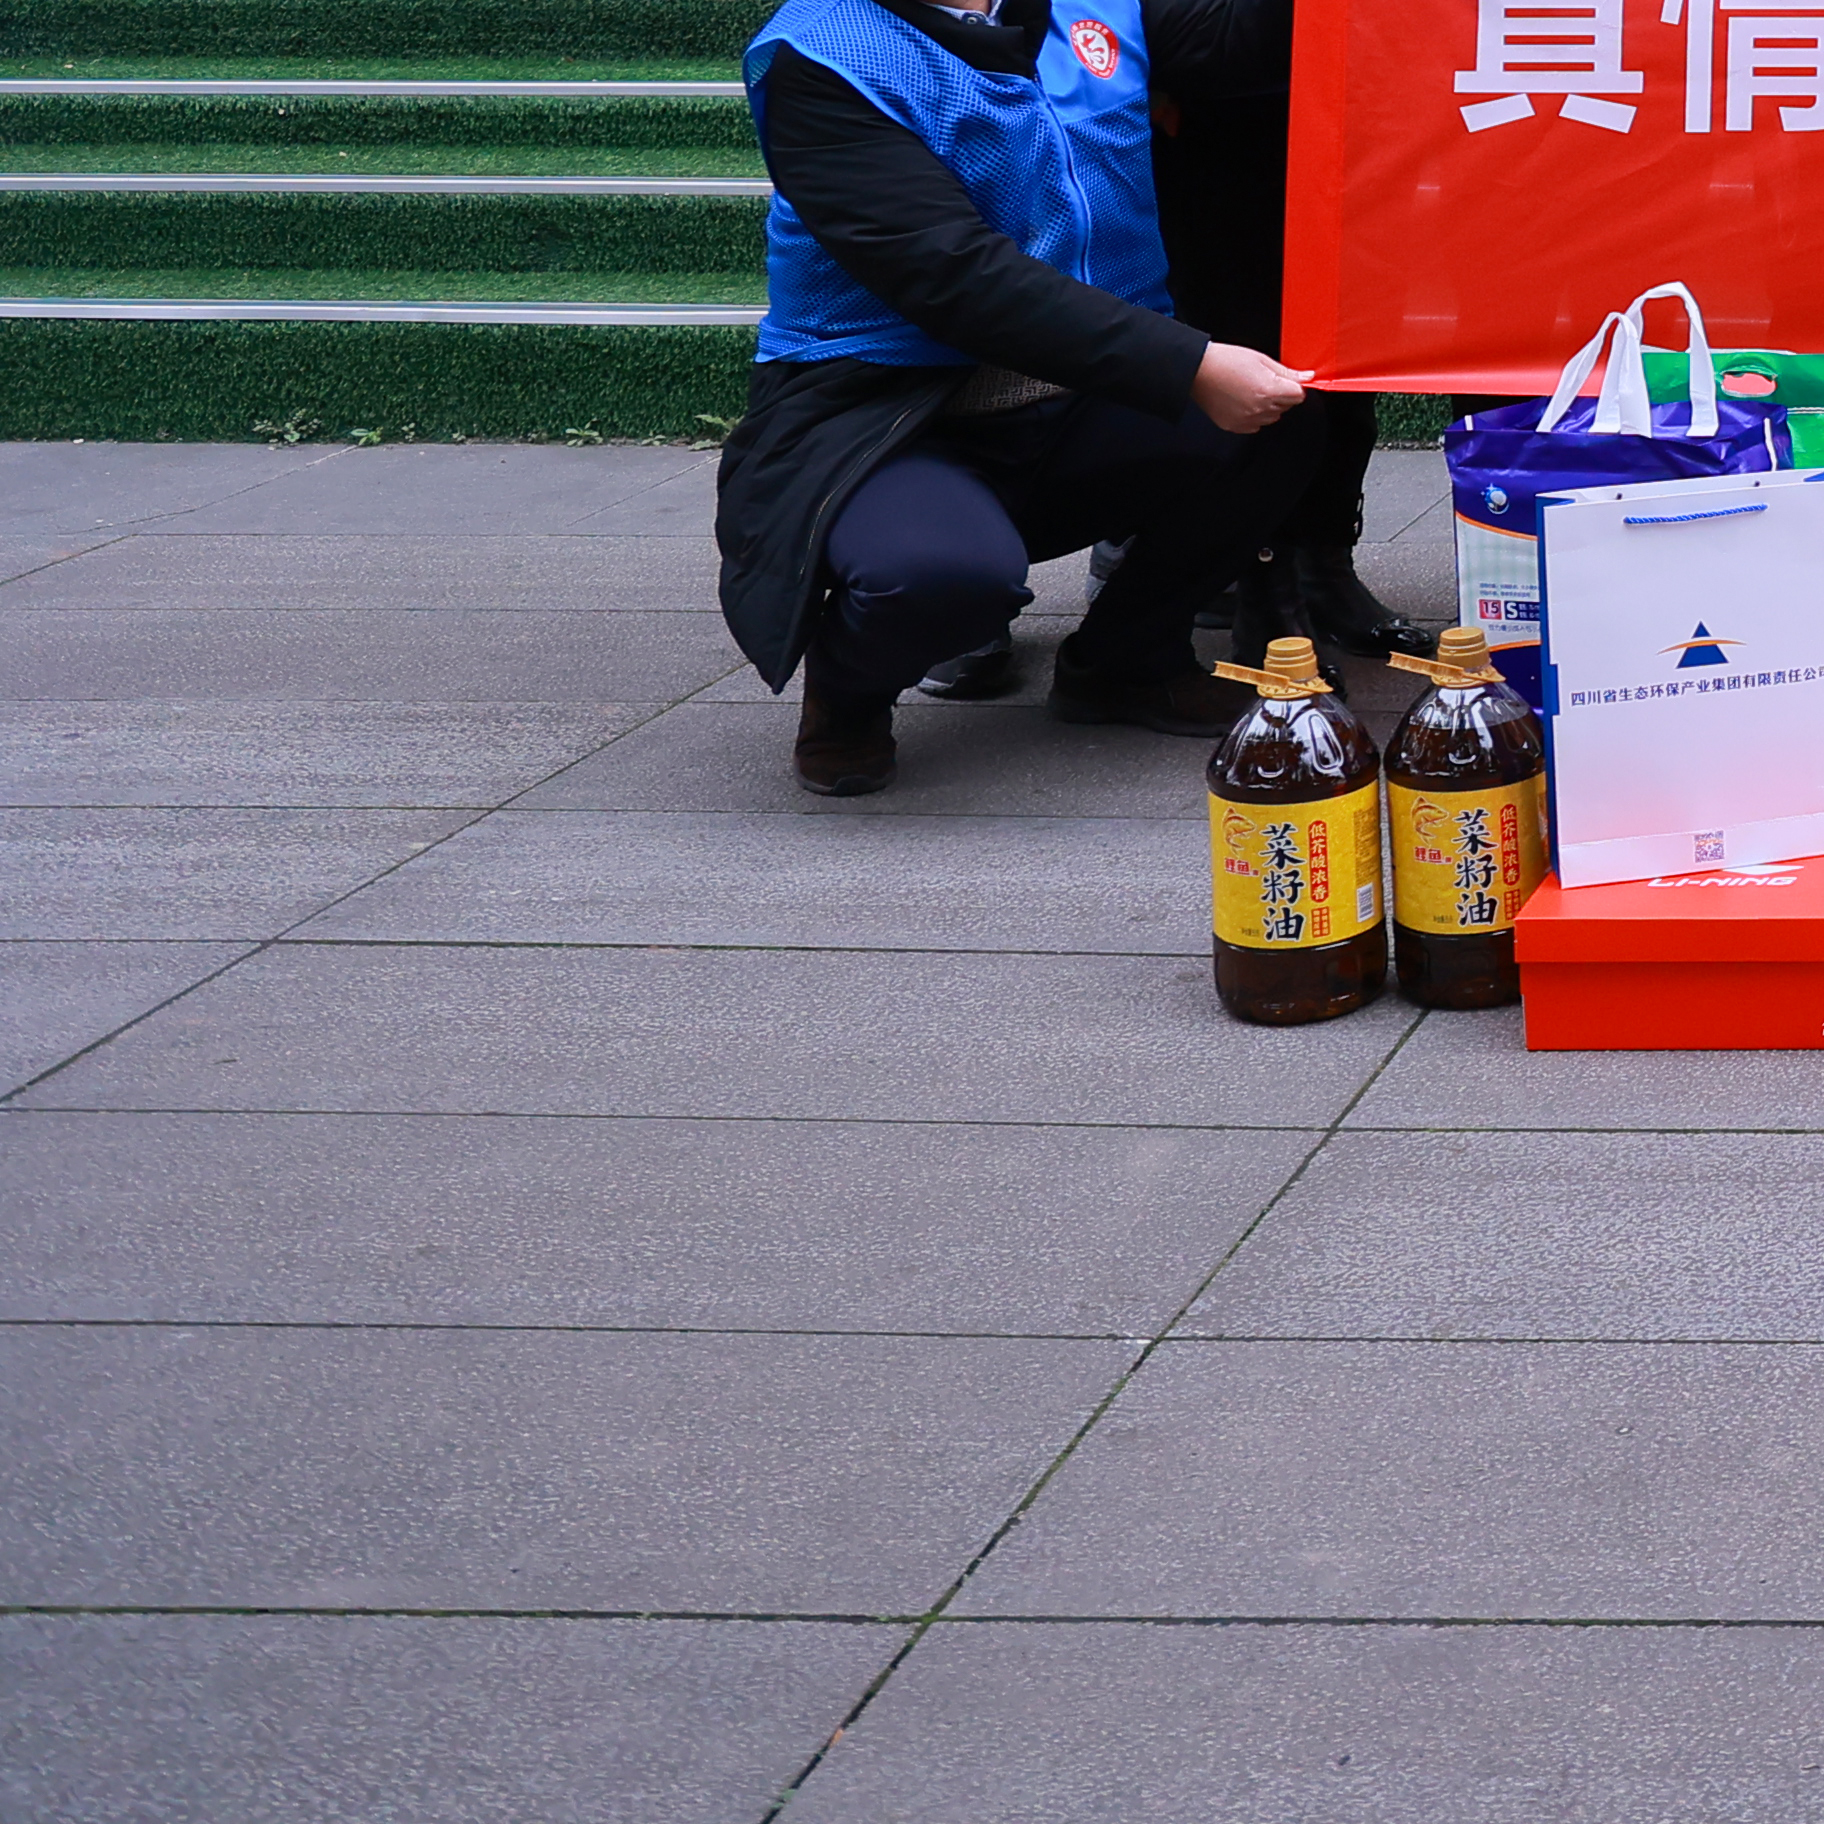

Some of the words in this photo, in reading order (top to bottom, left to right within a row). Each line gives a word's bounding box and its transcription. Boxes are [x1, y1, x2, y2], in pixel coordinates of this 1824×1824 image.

[1483, 600, 1501, 616] 15
[1506, 601, 1519, 619] S
[1259, 821, 1306, 943] 菜籽油
[1451, 808, 1499, 927] 菜籽油
[1648, 876, 1798, 887] LI-NING
